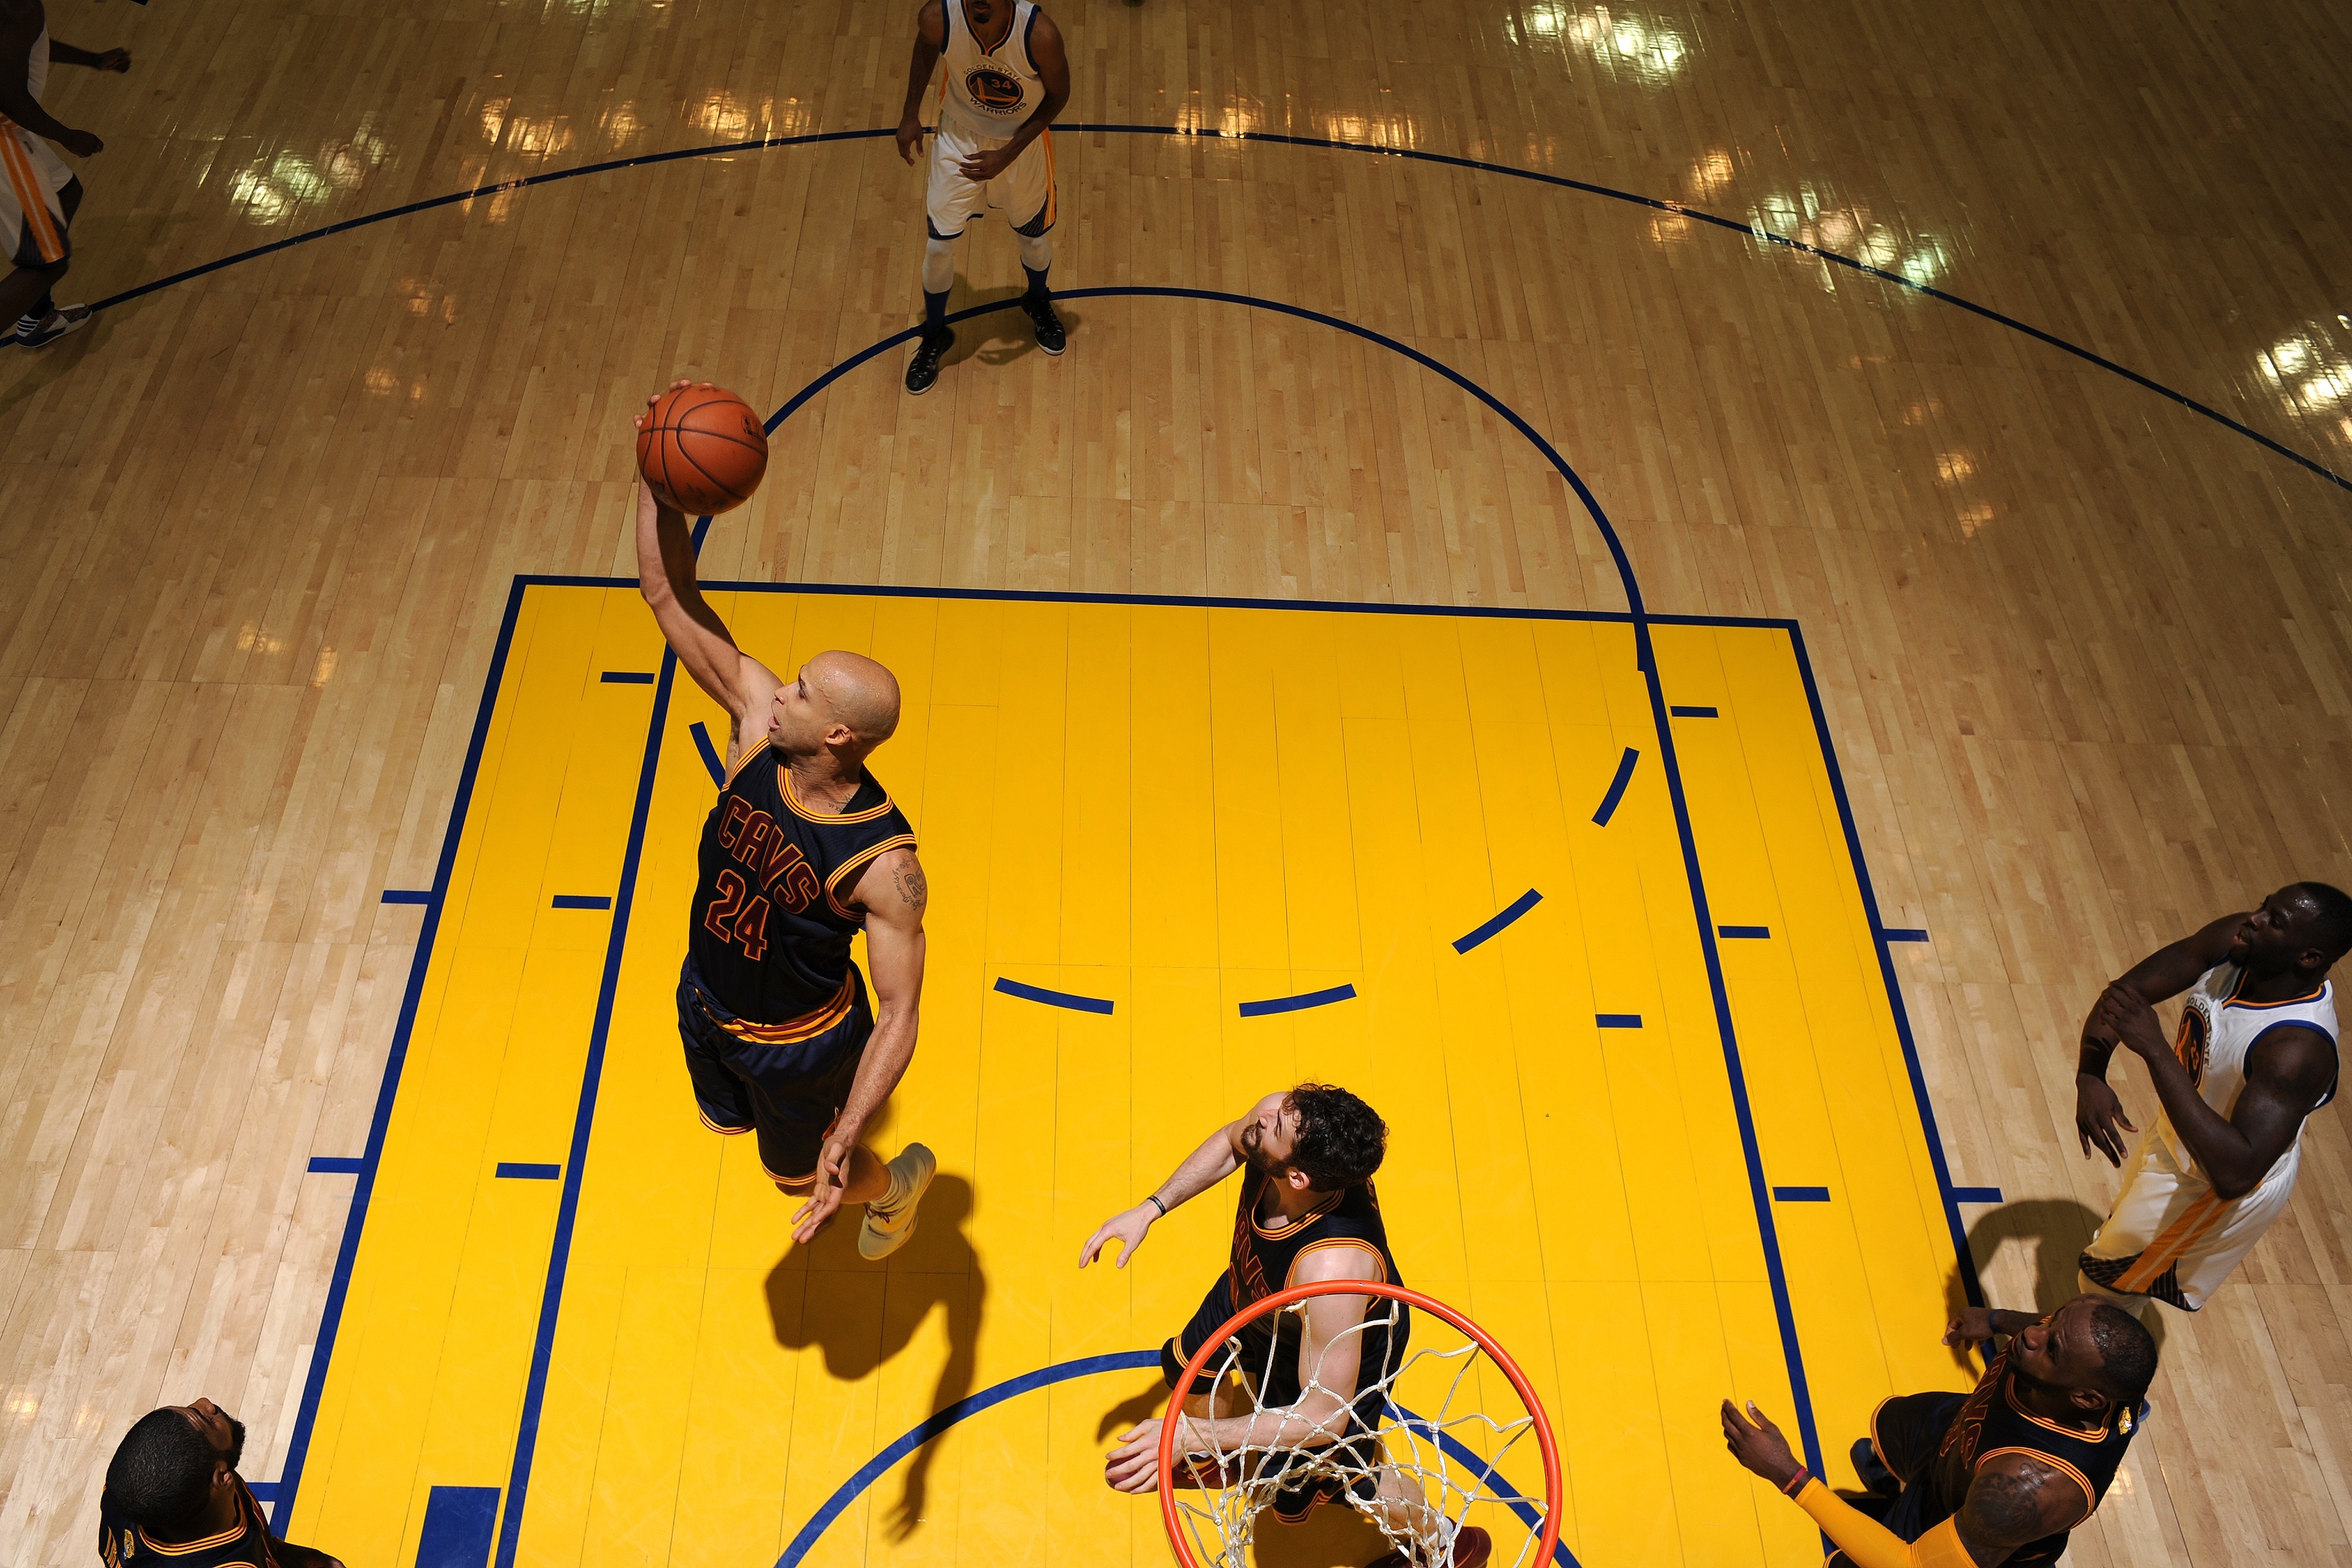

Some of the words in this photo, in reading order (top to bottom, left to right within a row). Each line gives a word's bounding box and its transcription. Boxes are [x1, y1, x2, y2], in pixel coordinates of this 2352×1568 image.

[963, 64, 994, 75] GOLDEN
[998, 67, 1021, 82] STATE
[991, 78, 1012, 90] 34
[970, 97, 1027, 116] WARRIORS
[719, 794, 820, 914] CAVS
[704, 869, 770, 961] 24
